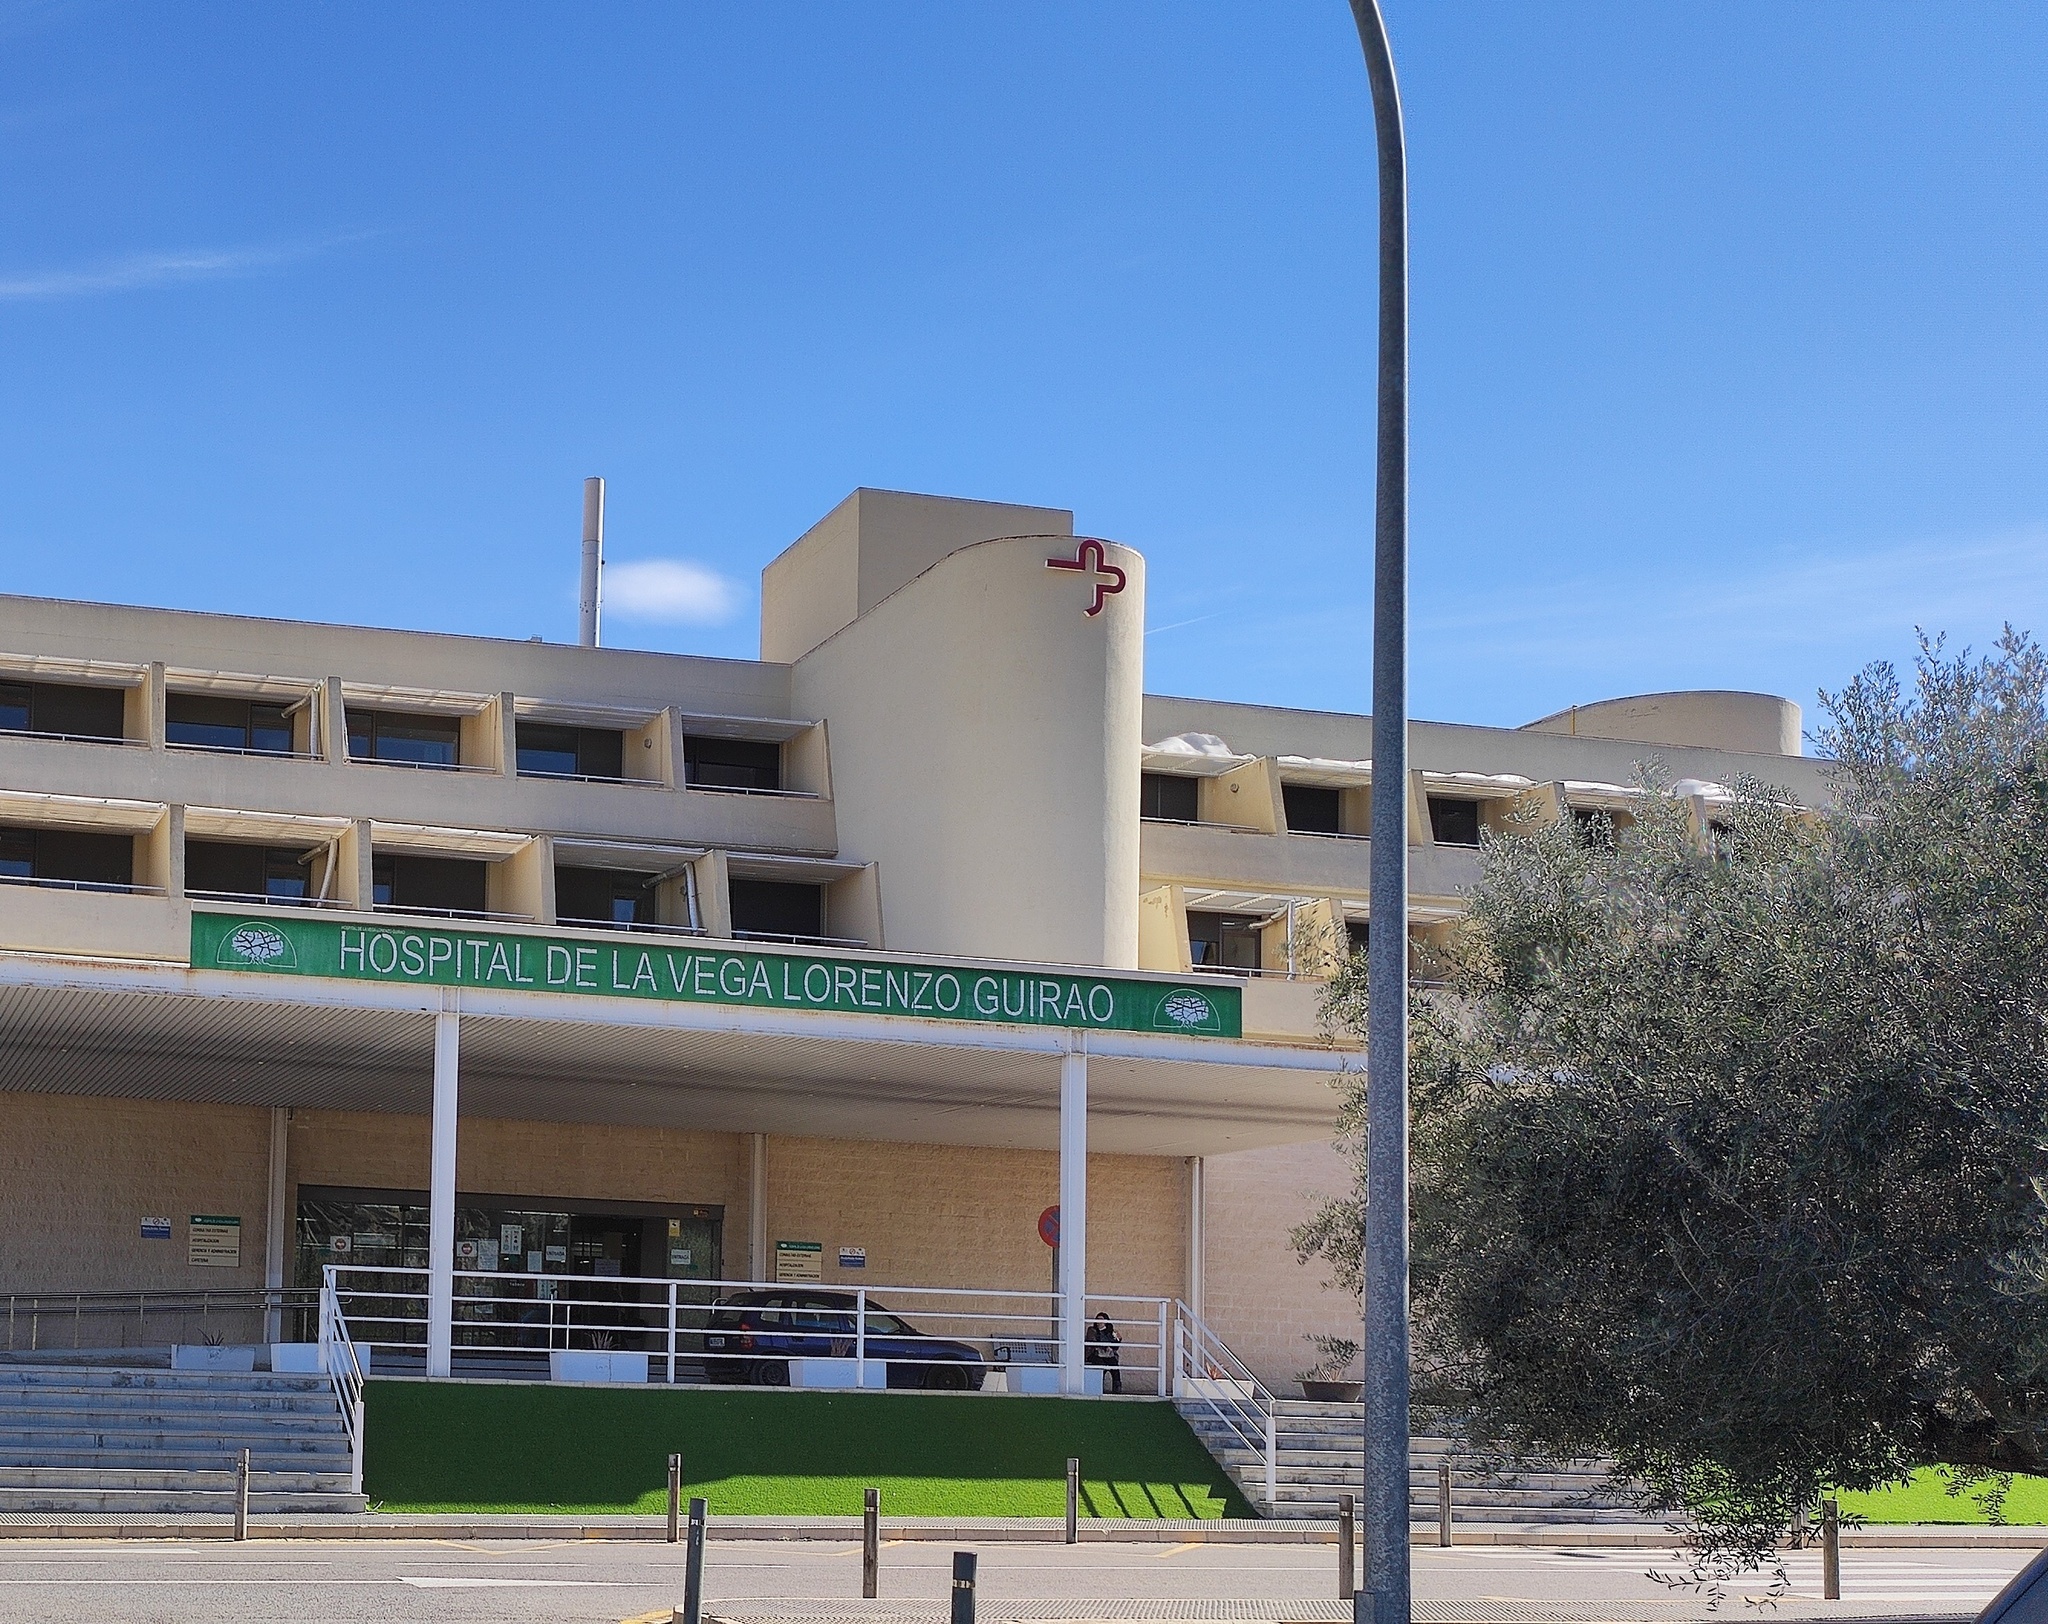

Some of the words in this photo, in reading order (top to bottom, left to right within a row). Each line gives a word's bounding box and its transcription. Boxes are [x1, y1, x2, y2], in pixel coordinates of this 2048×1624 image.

[340, 930, 534, 982] HOSPITAL
[547, 945, 597, 987] DE
[612, 950, 657, 992] LA
[667, 953, 773, 999] VEGA
[784, 962, 961, 1012] LORENZO
[973, 976, 1114, 1022] GUIRAO
